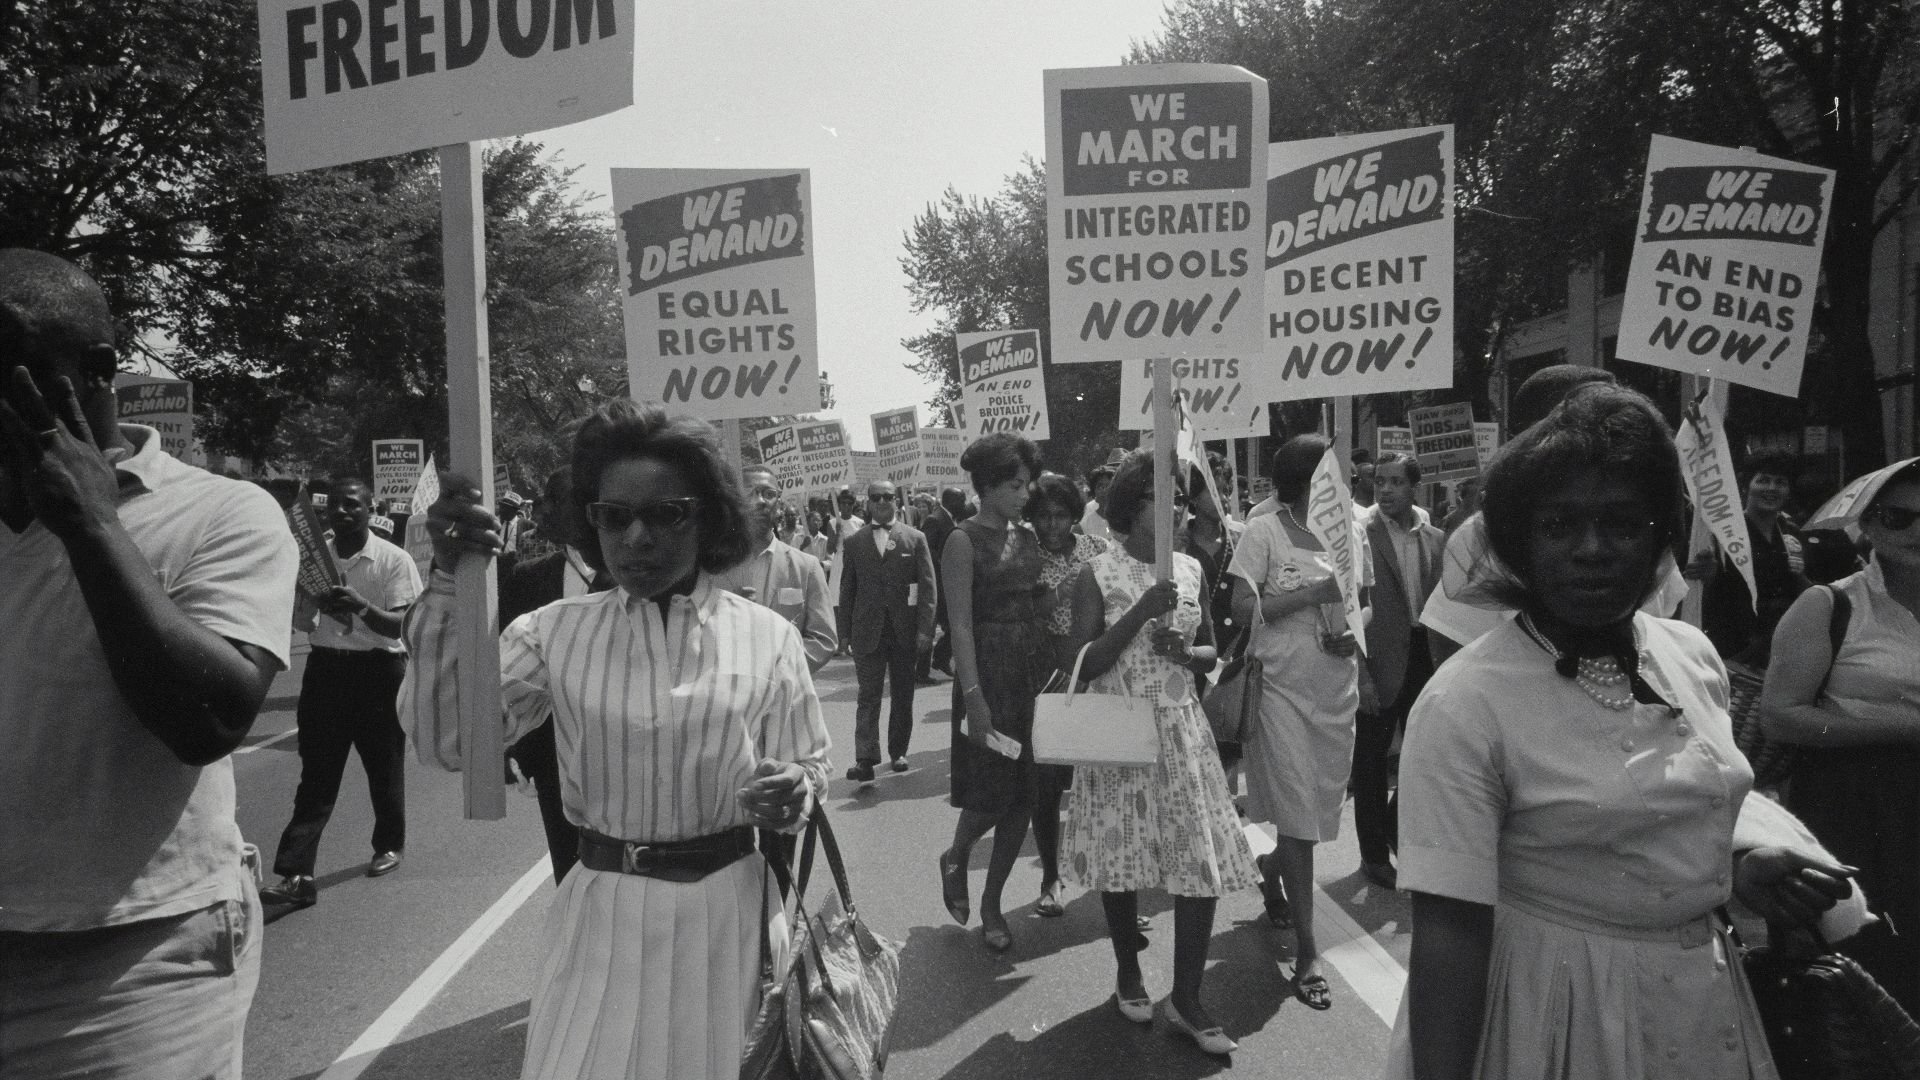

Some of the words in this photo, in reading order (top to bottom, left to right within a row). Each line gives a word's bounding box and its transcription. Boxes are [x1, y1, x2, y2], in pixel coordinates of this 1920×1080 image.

[1130, 92, 1185, 121] WE
[1077, 125, 1238, 165] MARCH
[1128, 169, 1189, 186] FOR
[1313, 151, 1382, 203] WE
[1706, 170, 1773, 199] WE
[682, 187, 746, 231] WE
[1065, 200, 1250, 239] INTEGRATED
[1266, 174, 1438, 258] DEMAND
[1656, 202, 1816, 235] DEMAND
[641, 214, 798, 281] DEMAND
[1066, 248, 1249, 285] SCHOOLS
[1283, 255, 1428, 296] DECENT
[1655, 248, 1711, 281] AN
[1725, 260, 1803, 299] END
[658, 288, 789, 320] EQUAL
[1080, 287, 1241, 342] NOW!
[1655, 280, 1702, 311] TO
[1713, 295, 1795, 333] BIAS
[1269, 297, 1441, 339] HOUSING
[659, 324, 795, 356] RIGHTS
[986, 337, 1013, 357] WE
[1648, 317, 1791, 370] NOW!
[969, 348, 1034, 380] DEMAND
[1281, 327, 1433, 382] NOW!
[663, 355, 800, 404] NOW!
[1144, 358, 1239, 379] RGHTS
[140, 384, 166, 398] WE
[975, 381, 998, 392] AN
[1003, 380, 1031, 390] END
[122, 396, 186, 415] DEMAND
[979, 405, 1031, 417] BRUTALITY
[989, 395, 1023, 406] POLICE
[813, 427, 827, 435] WE
[880, 422, 913, 438] MARCH
[981, 411, 1040, 434] NOW!
[1415, 420, 1452, 436] JOBS
[775, 428, 792, 443] WE
[803, 432, 840, 445] MARCH
[1416, 433, 1474, 454] FREEDOM
[802, 448, 847, 462] INTEGRATED
[880, 447, 898, 458] FIRST
[900, 441, 919, 453] CLASS
[880, 451, 921, 468] CITIZENSHIP
[771, 457, 783, 466] AN
[780, 463, 801, 473] POLICE
[804, 459, 848, 473] SCHOOLS
[888, 462, 919, 481] NOW!
[926, 465, 958, 475] REEDOM
[811, 468, 848, 485] NOW!
[1310, 471, 1351, 577] FREEDOM
[1722, 524, 1733, 538] IN
[1728, 536, 1749, 567] '63
